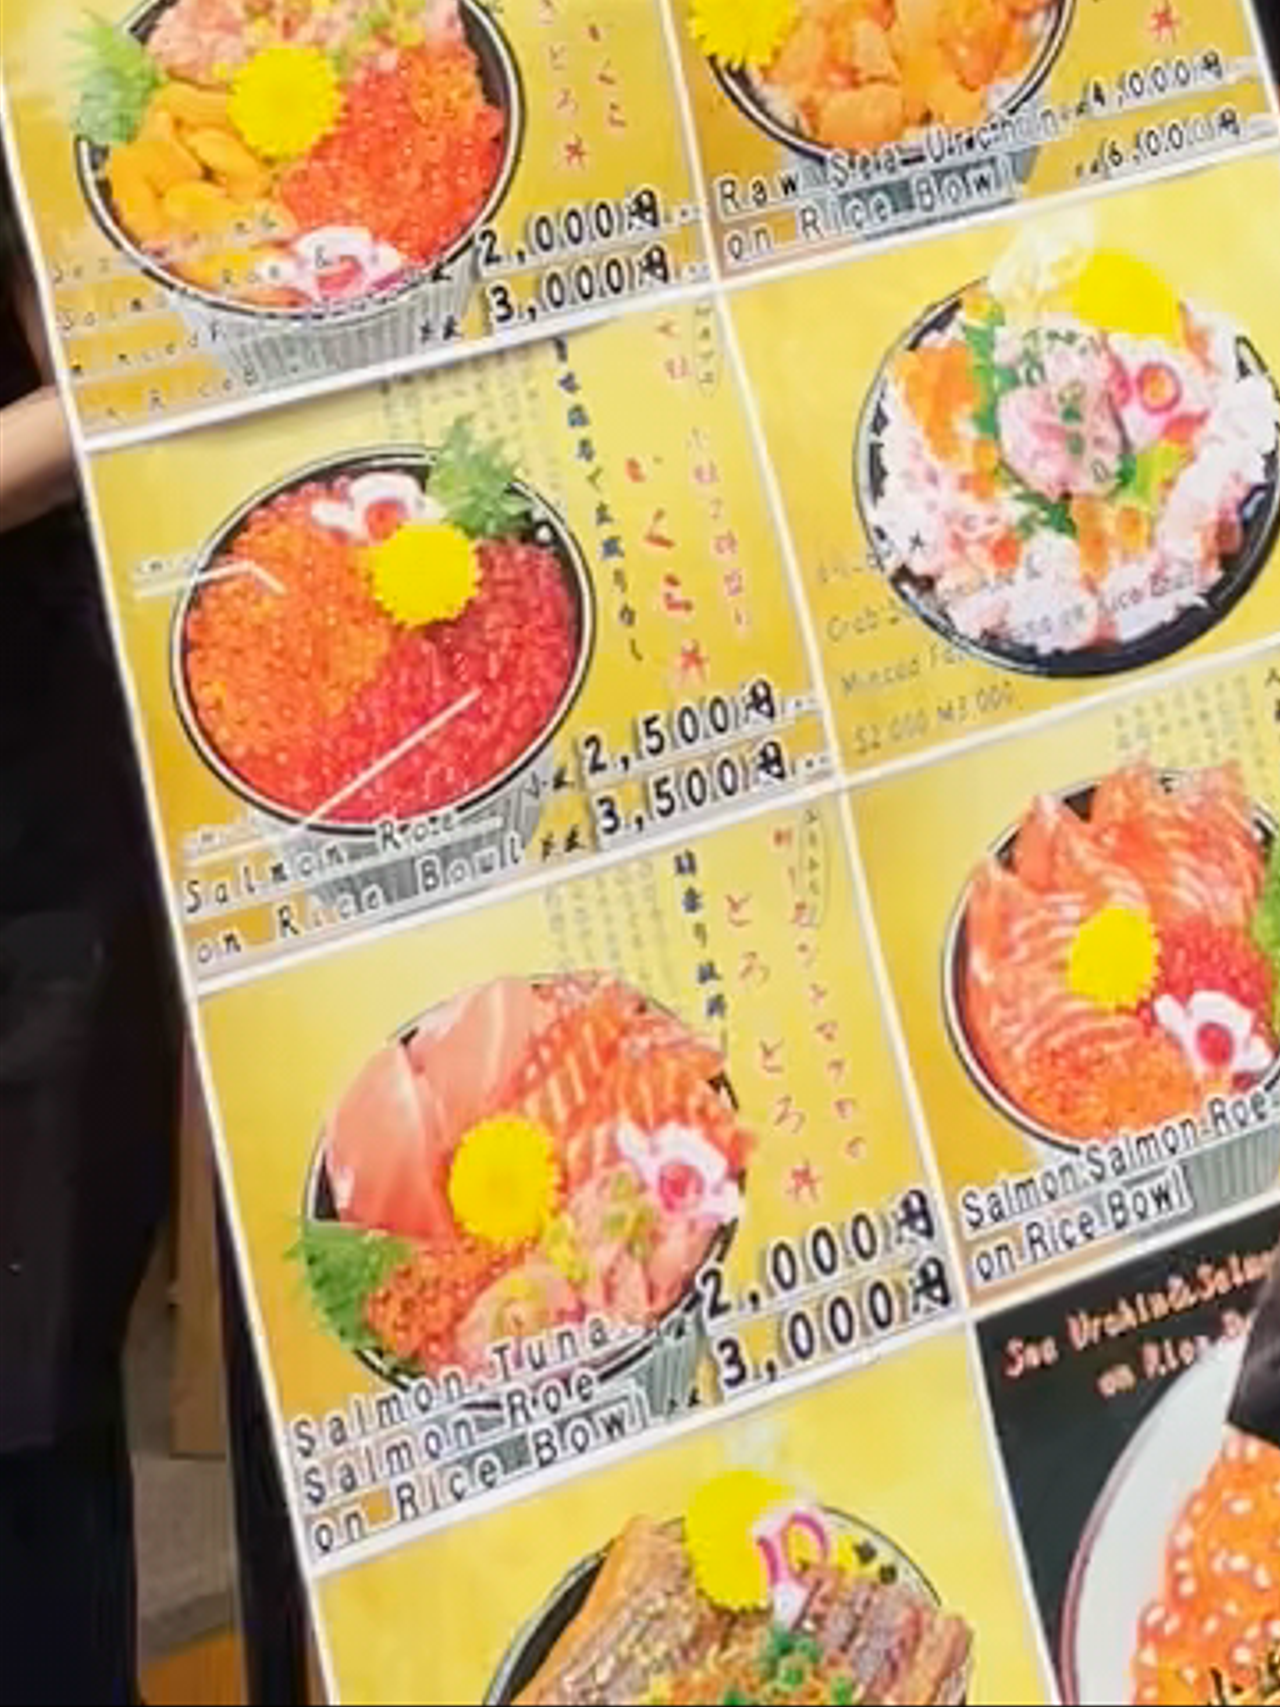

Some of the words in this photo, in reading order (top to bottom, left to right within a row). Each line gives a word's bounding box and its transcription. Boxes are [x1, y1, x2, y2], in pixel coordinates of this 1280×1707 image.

[720, 176, 798, 213] Raw
[726, 226, 773, 261] on
[800, 190, 892, 240] Rice
[914, 157, 1012, 212] Bowl
[186, 842, 344, 914] Salmon
[197, 931, 241, 964] on
[421, 835, 523, 893] Bowl
[1208, 1090, 1268, 1137] Roe
[976, 1240, 1016, 1281] on
[1025, 1206, 1093, 1264] Rice
[1107, 1162, 1195, 1230] Bowl
[303, 1415, 475, 1507] Salmon
[505, 1372, 594, 1430] Roe
[314, 1511, 363, 1555] on
[395, 1458, 498, 1523] Rice
[535, 1383, 650, 1468] Bowl
